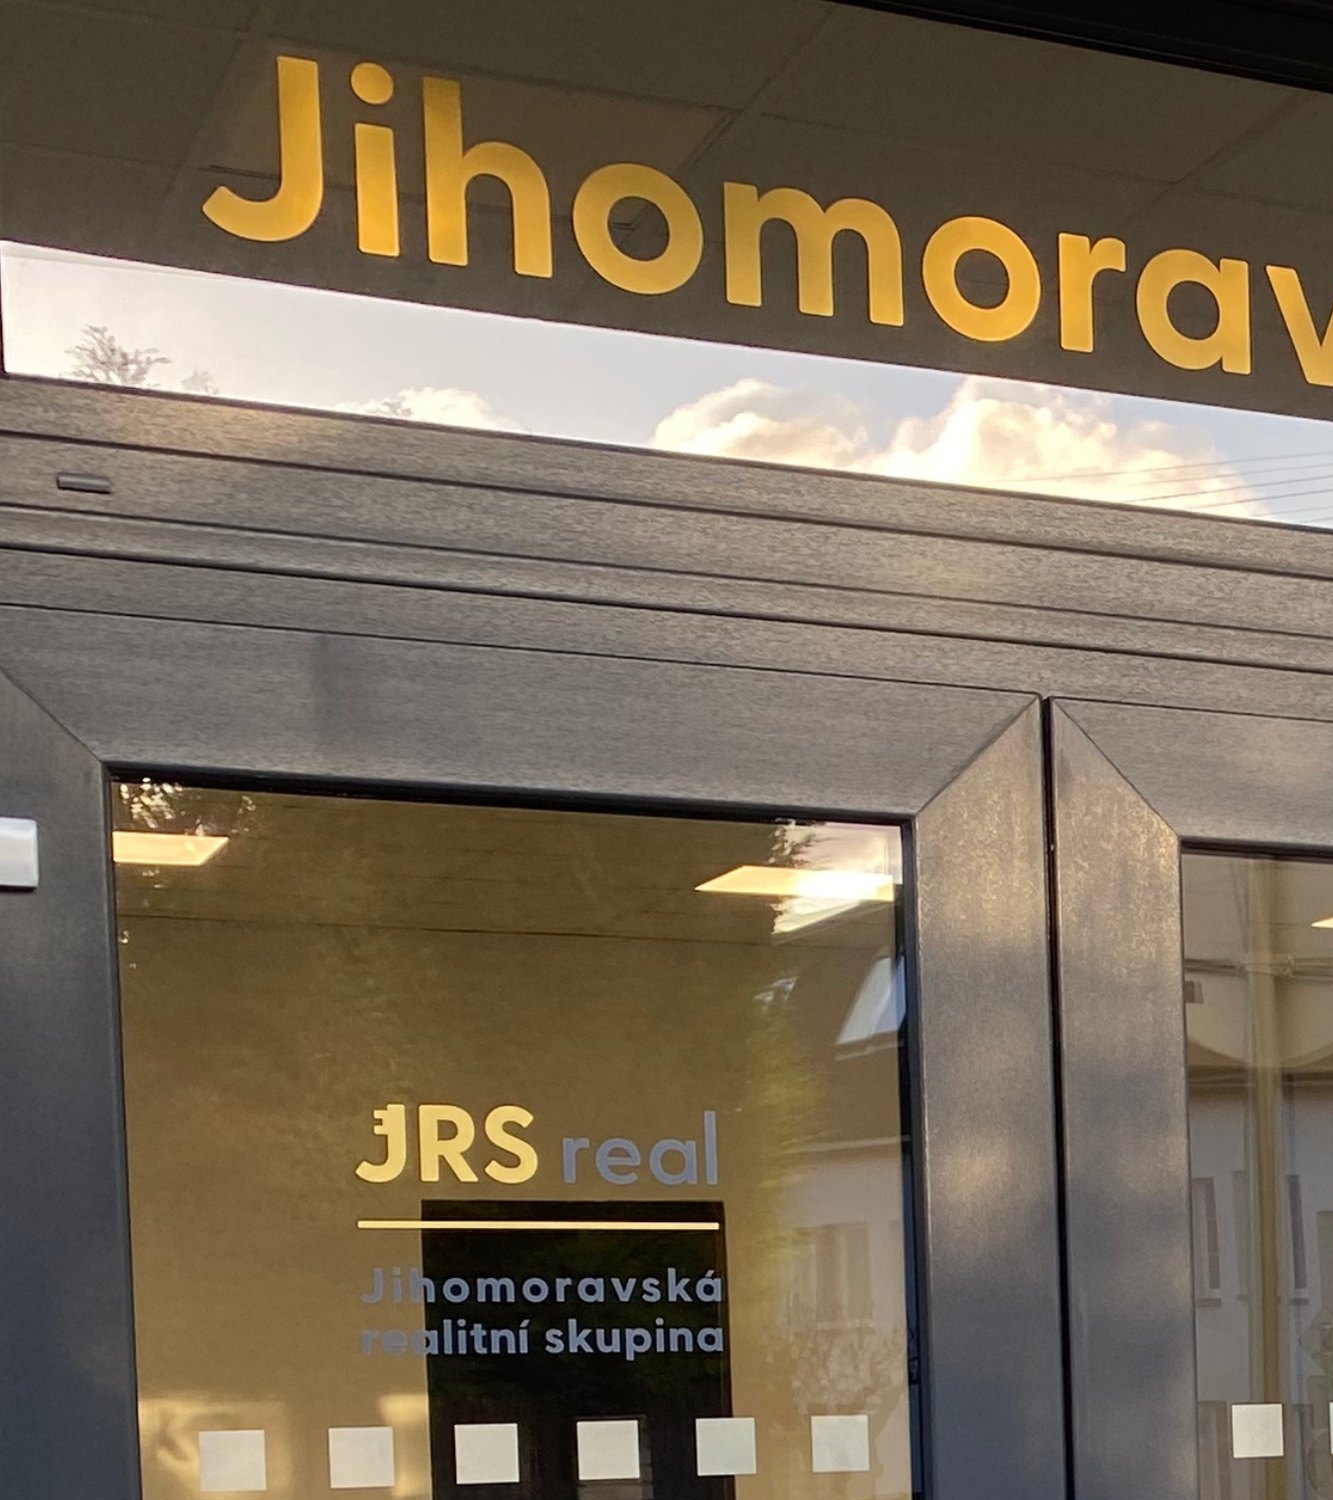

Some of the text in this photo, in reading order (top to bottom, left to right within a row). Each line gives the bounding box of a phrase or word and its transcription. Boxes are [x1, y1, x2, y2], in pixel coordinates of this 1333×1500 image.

[355, 1103, 719, 1186] JRS real
[360, 1267, 724, 1305] Jihomoravská
[361, 1317, 725, 1362] realitní skupina
